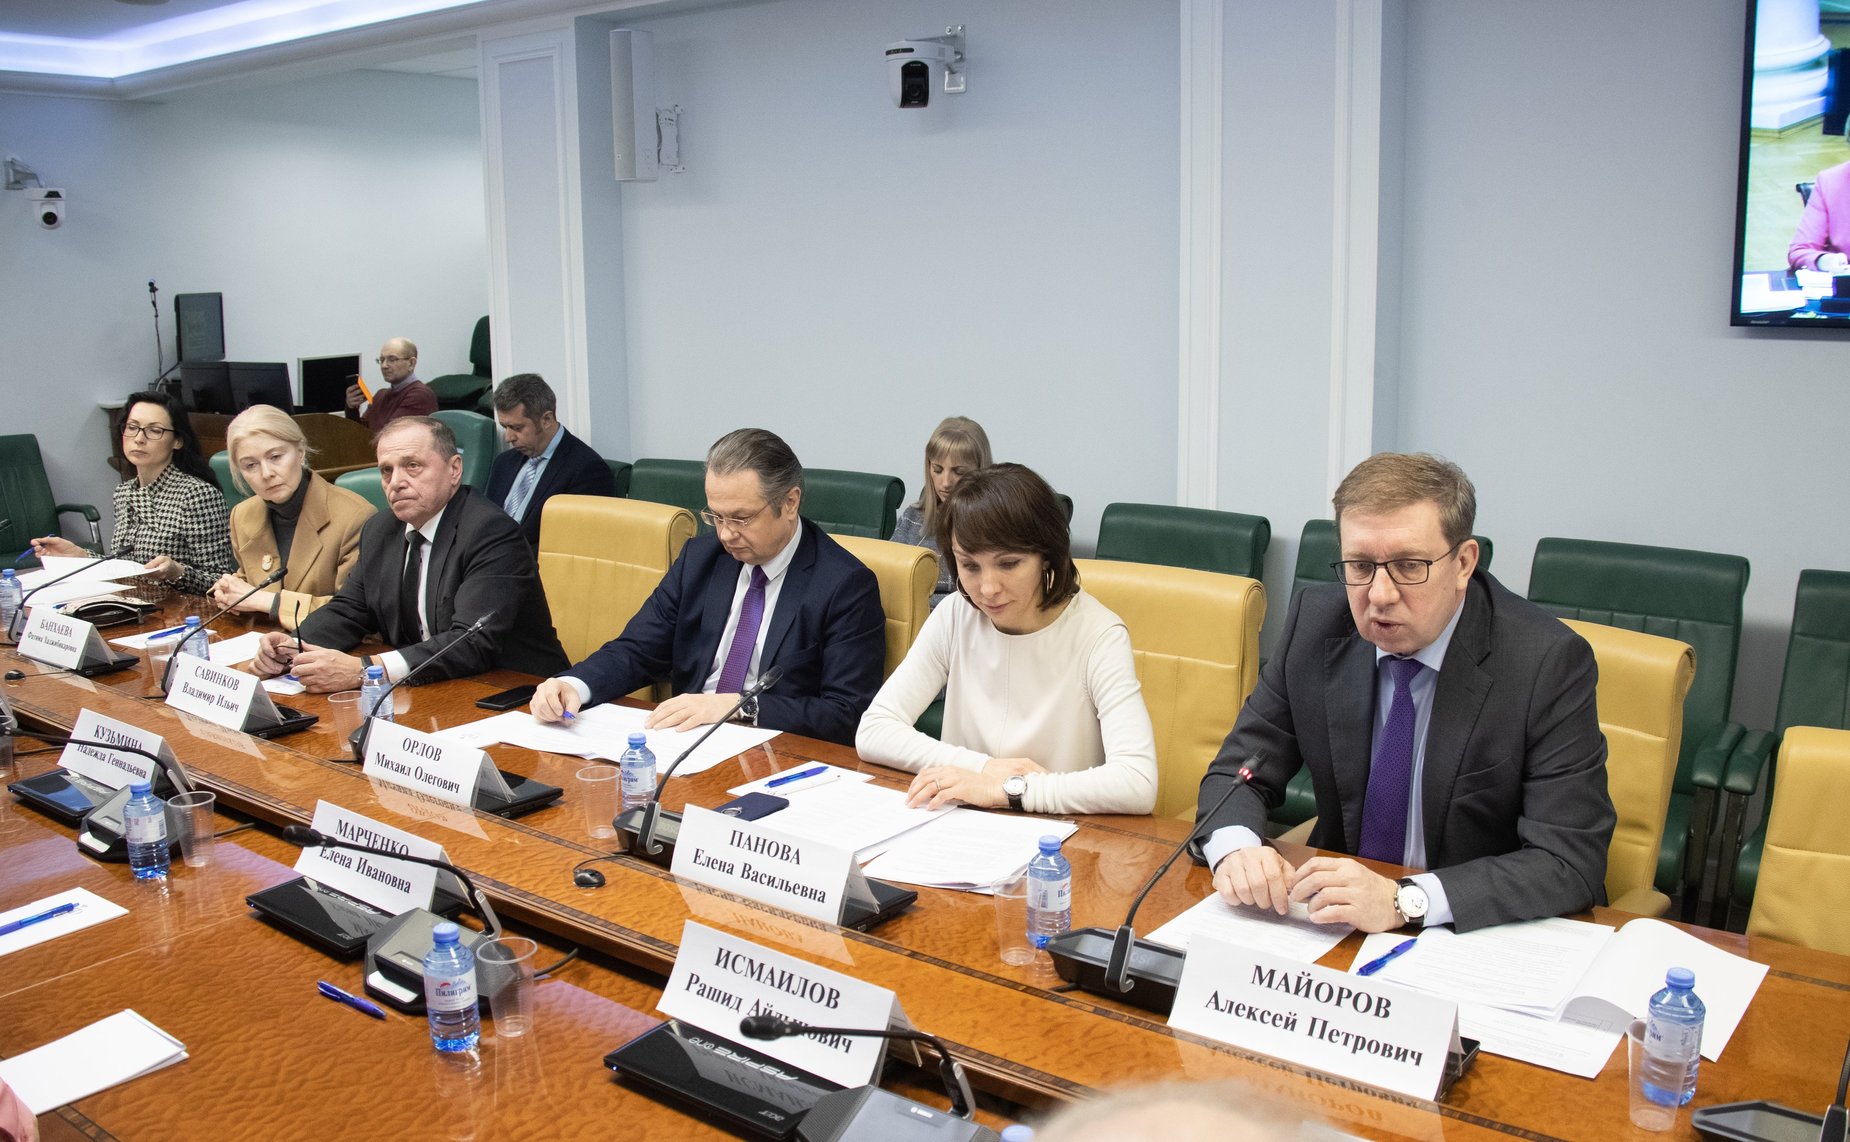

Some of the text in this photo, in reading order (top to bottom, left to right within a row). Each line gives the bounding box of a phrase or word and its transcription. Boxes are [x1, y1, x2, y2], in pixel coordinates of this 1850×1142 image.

[40, 619, 73, 638] БАНХАЕВА
[182, 682, 240, 713] Владимир Ильич
[194, 665, 240, 691] САВИНКОВ
[77, 743, 147, 779] Надежда Геннадьевна
[402, 737, 442, 762] ОРЛОВ
[374, 752, 411, 777] Михаил
[414, 765, 460, 794] Олегович
[335, 818, 410, 857] МАРЧЕНКО
[729, 829, 801, 865] ПАНОВА
[319, 846, 412, 894] Елена Ивановна
[692, 848, 734, 875] Елена
[740, 862, 827, 903] Васильевна
[714, 947, 841, 1010] ИСМАИЛОВ
[1250, 964, 1392, 1019] МАЙОРОВ
[685, 972, 853, 1054] Рашид Айович
[1205, 989, 1298, 1032] Алексей
[1307, 1016, 1424, 1067] Петрович
[688, 1036, 799, 1081] ASPIRE one
